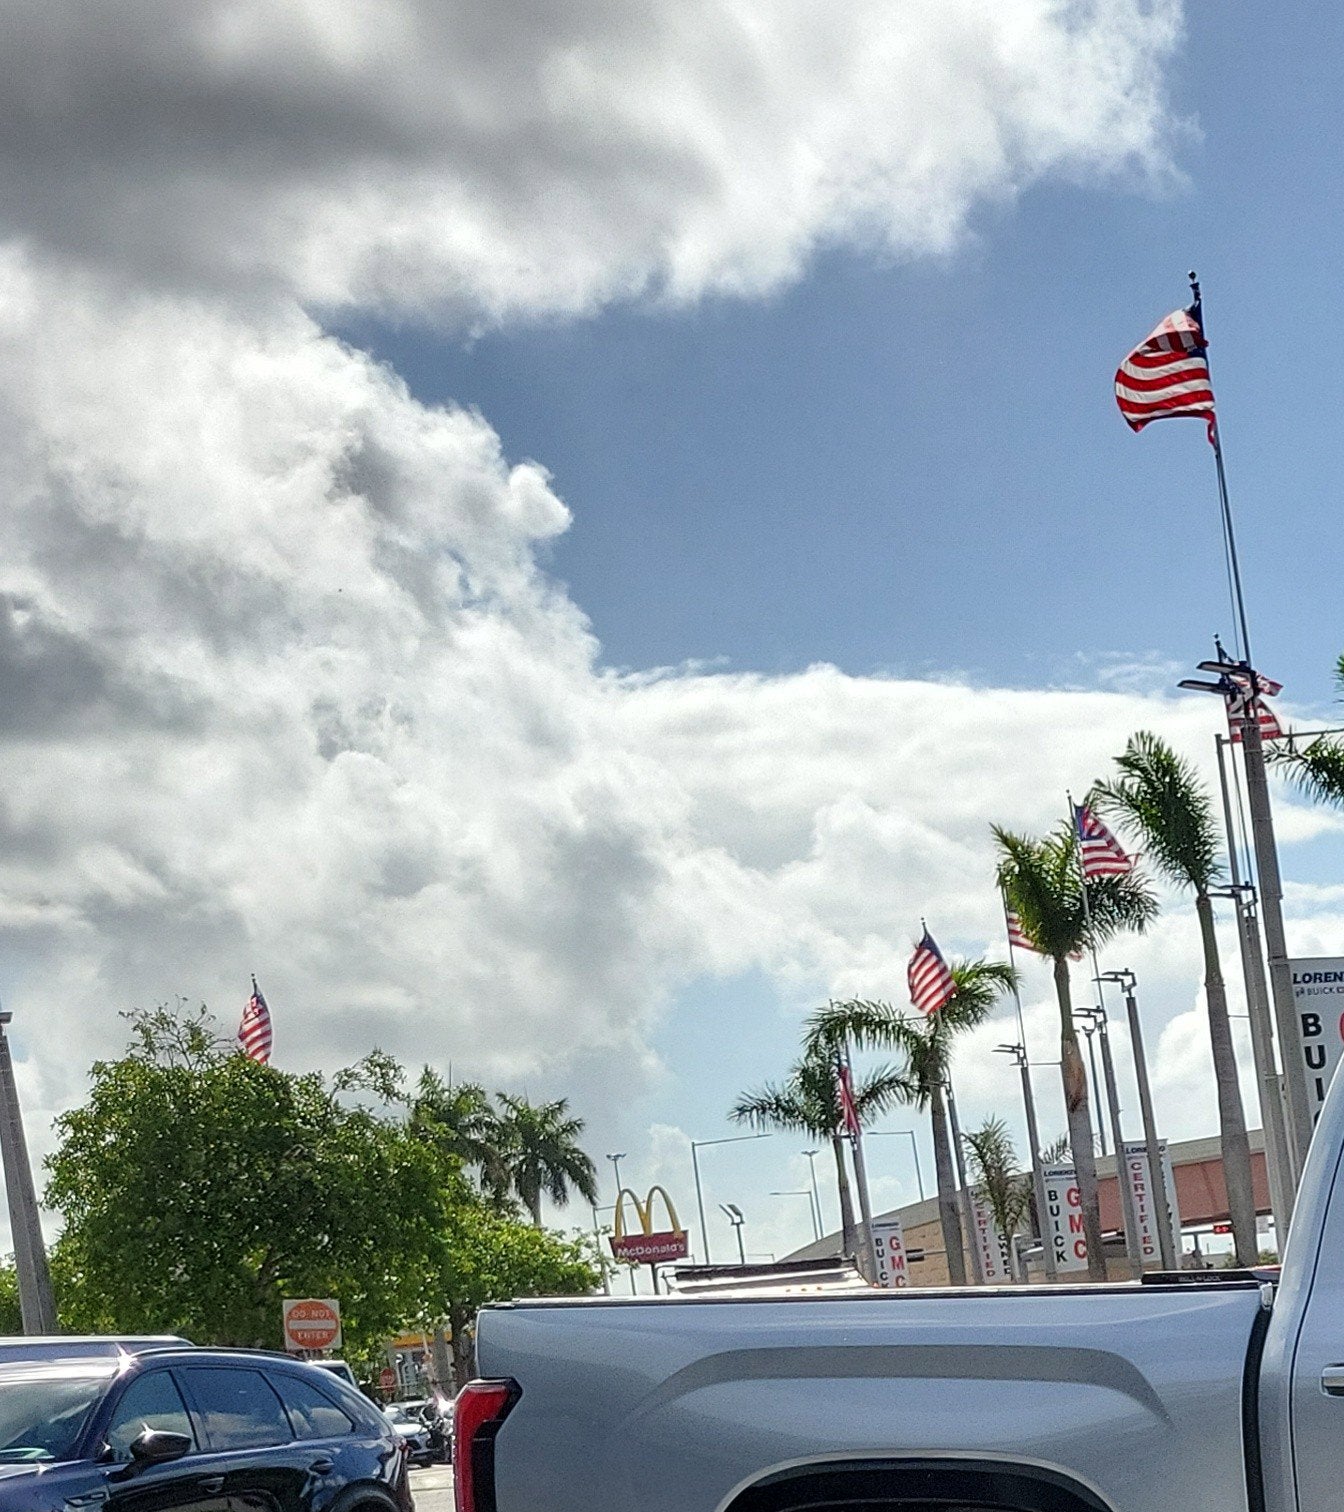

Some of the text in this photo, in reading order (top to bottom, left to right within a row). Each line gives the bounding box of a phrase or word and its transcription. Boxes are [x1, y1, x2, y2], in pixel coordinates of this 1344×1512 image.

[1307, 987, 1336, 996] BUICK
[1301, 1013, 1326, 1128] BUI
[1047, 1190, 1068, 1263] BUICK
[1067, 1187, 1087, 1259] GMC
[1131, 1162, 1154, 1255] CERTIFIED
[617, 1243, 685, 1256] McDonald's
[889, 1236, 905, 1287] GMC
[298, 1330, 329, 1340] ENTER
[311, 1309, 332, 1319] NOT
